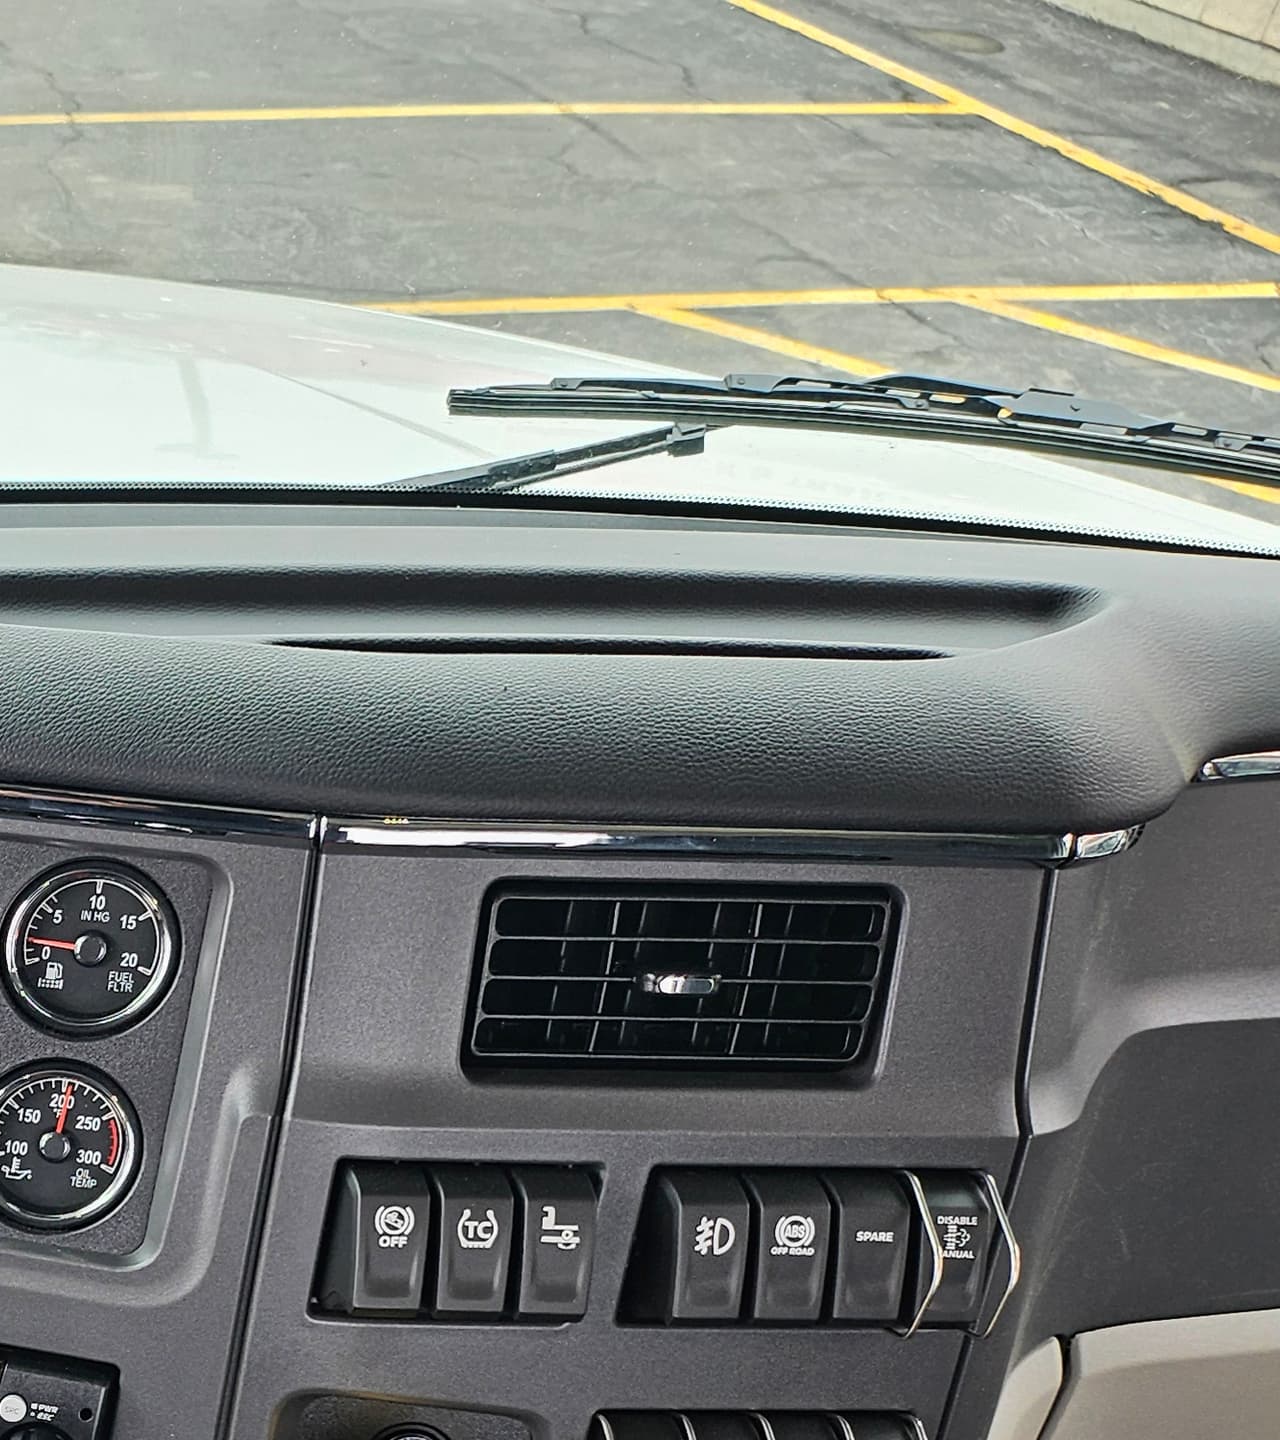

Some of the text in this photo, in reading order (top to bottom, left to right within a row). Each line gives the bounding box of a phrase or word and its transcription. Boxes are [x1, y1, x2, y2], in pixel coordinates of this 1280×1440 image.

[89, 895, 106, 910] 10
[52, 909, 63, 924] 5
[80, 910, 110, 923] IN HG
[120, 915, 137, 930] 15
[41, 946, 51, 960] 0
[120, 952, 138, 968] 20
[108, 970, 134, 984] FUEL
[107, 981, 133, 993] FLTR
[17, 1107, 41, 1124] 150
[75, 1115, 101, 1131] 250
[4, 1140, 28, 1156] 100
[76, 1149, 101, 1165] 300
[75, 1168, 90, 1179] OIL
[70, 1176, 97, 1188] TEMP
[937, 1216, 978, 1226] DISABLE
[465, 1221, 492, 1240] TC
[783, 1224, 805, 1238] ABS
[856, 1231, 894, 1243] SPARE
[378, 1236, 408, 1248] OFF
[770, 1247, 815, 1257] OFF ROAD
[939, 1249, 975, 1259] ANUAL
